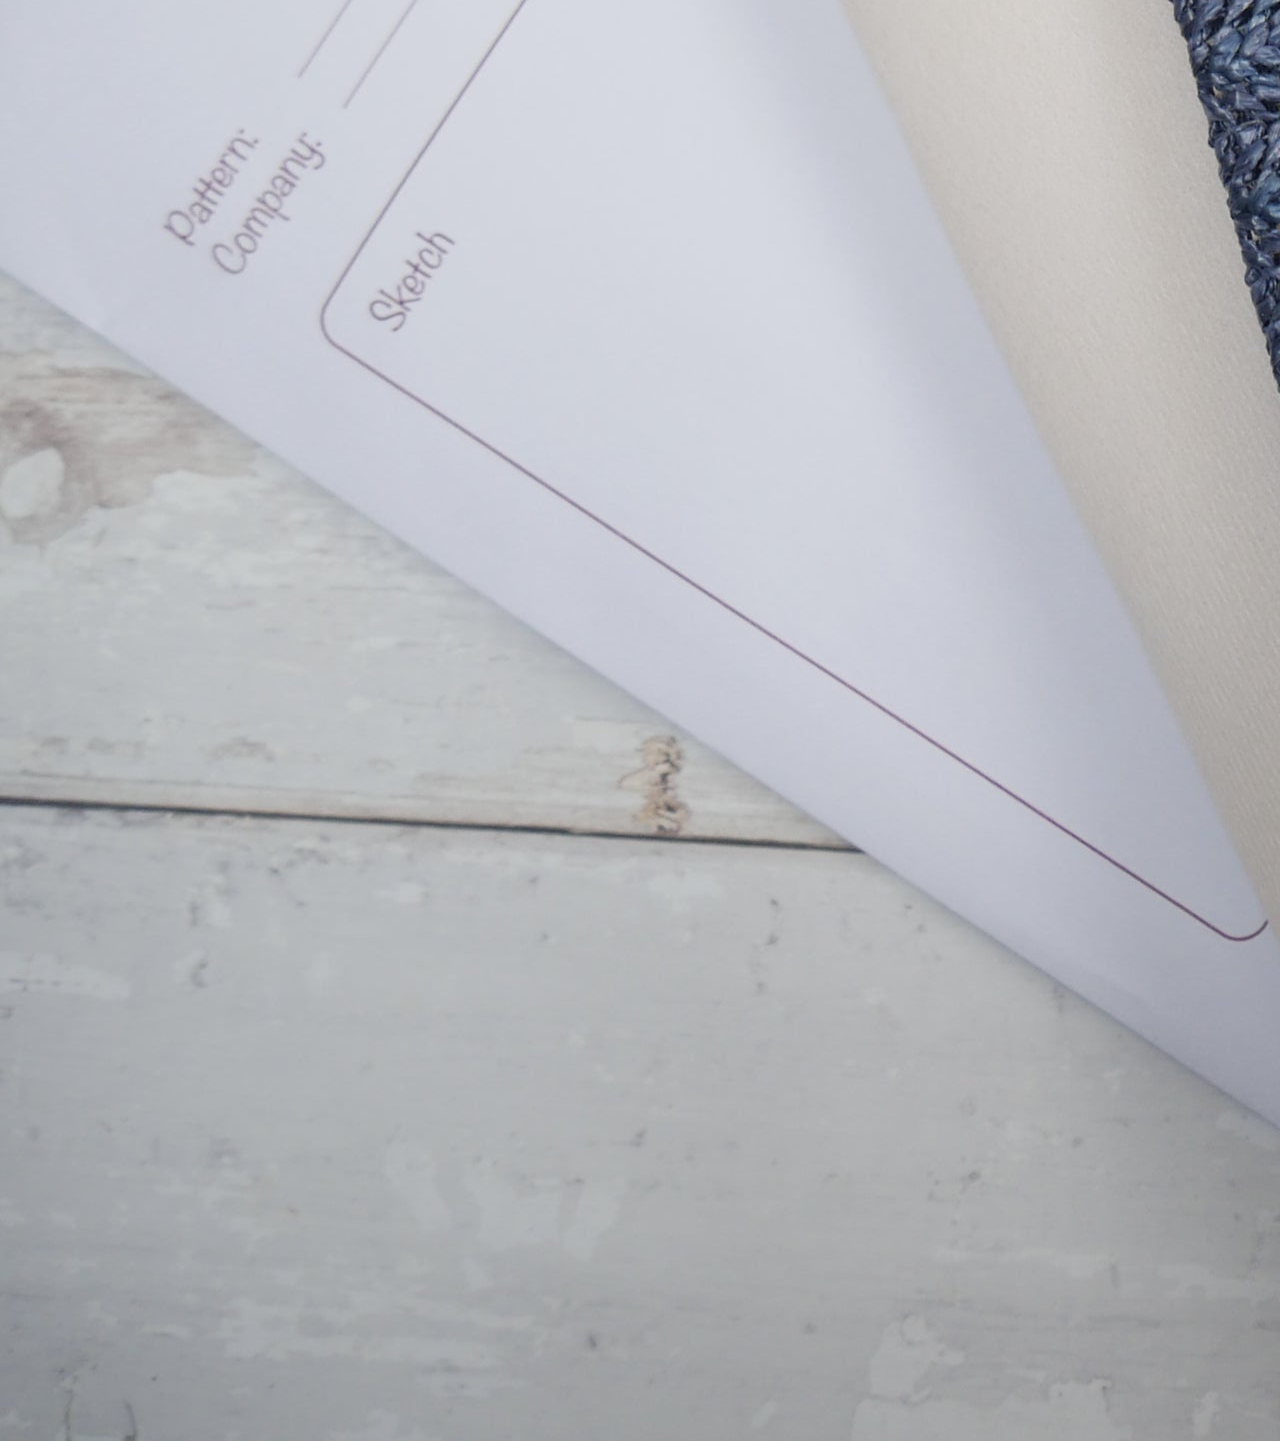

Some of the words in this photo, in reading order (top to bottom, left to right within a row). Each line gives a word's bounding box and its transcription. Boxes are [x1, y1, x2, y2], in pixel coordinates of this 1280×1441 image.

[162, 128, 260, 247] Pattern:
[210, 131, 326, 275] Company:
[367, 230, 456, 333] Sketch
